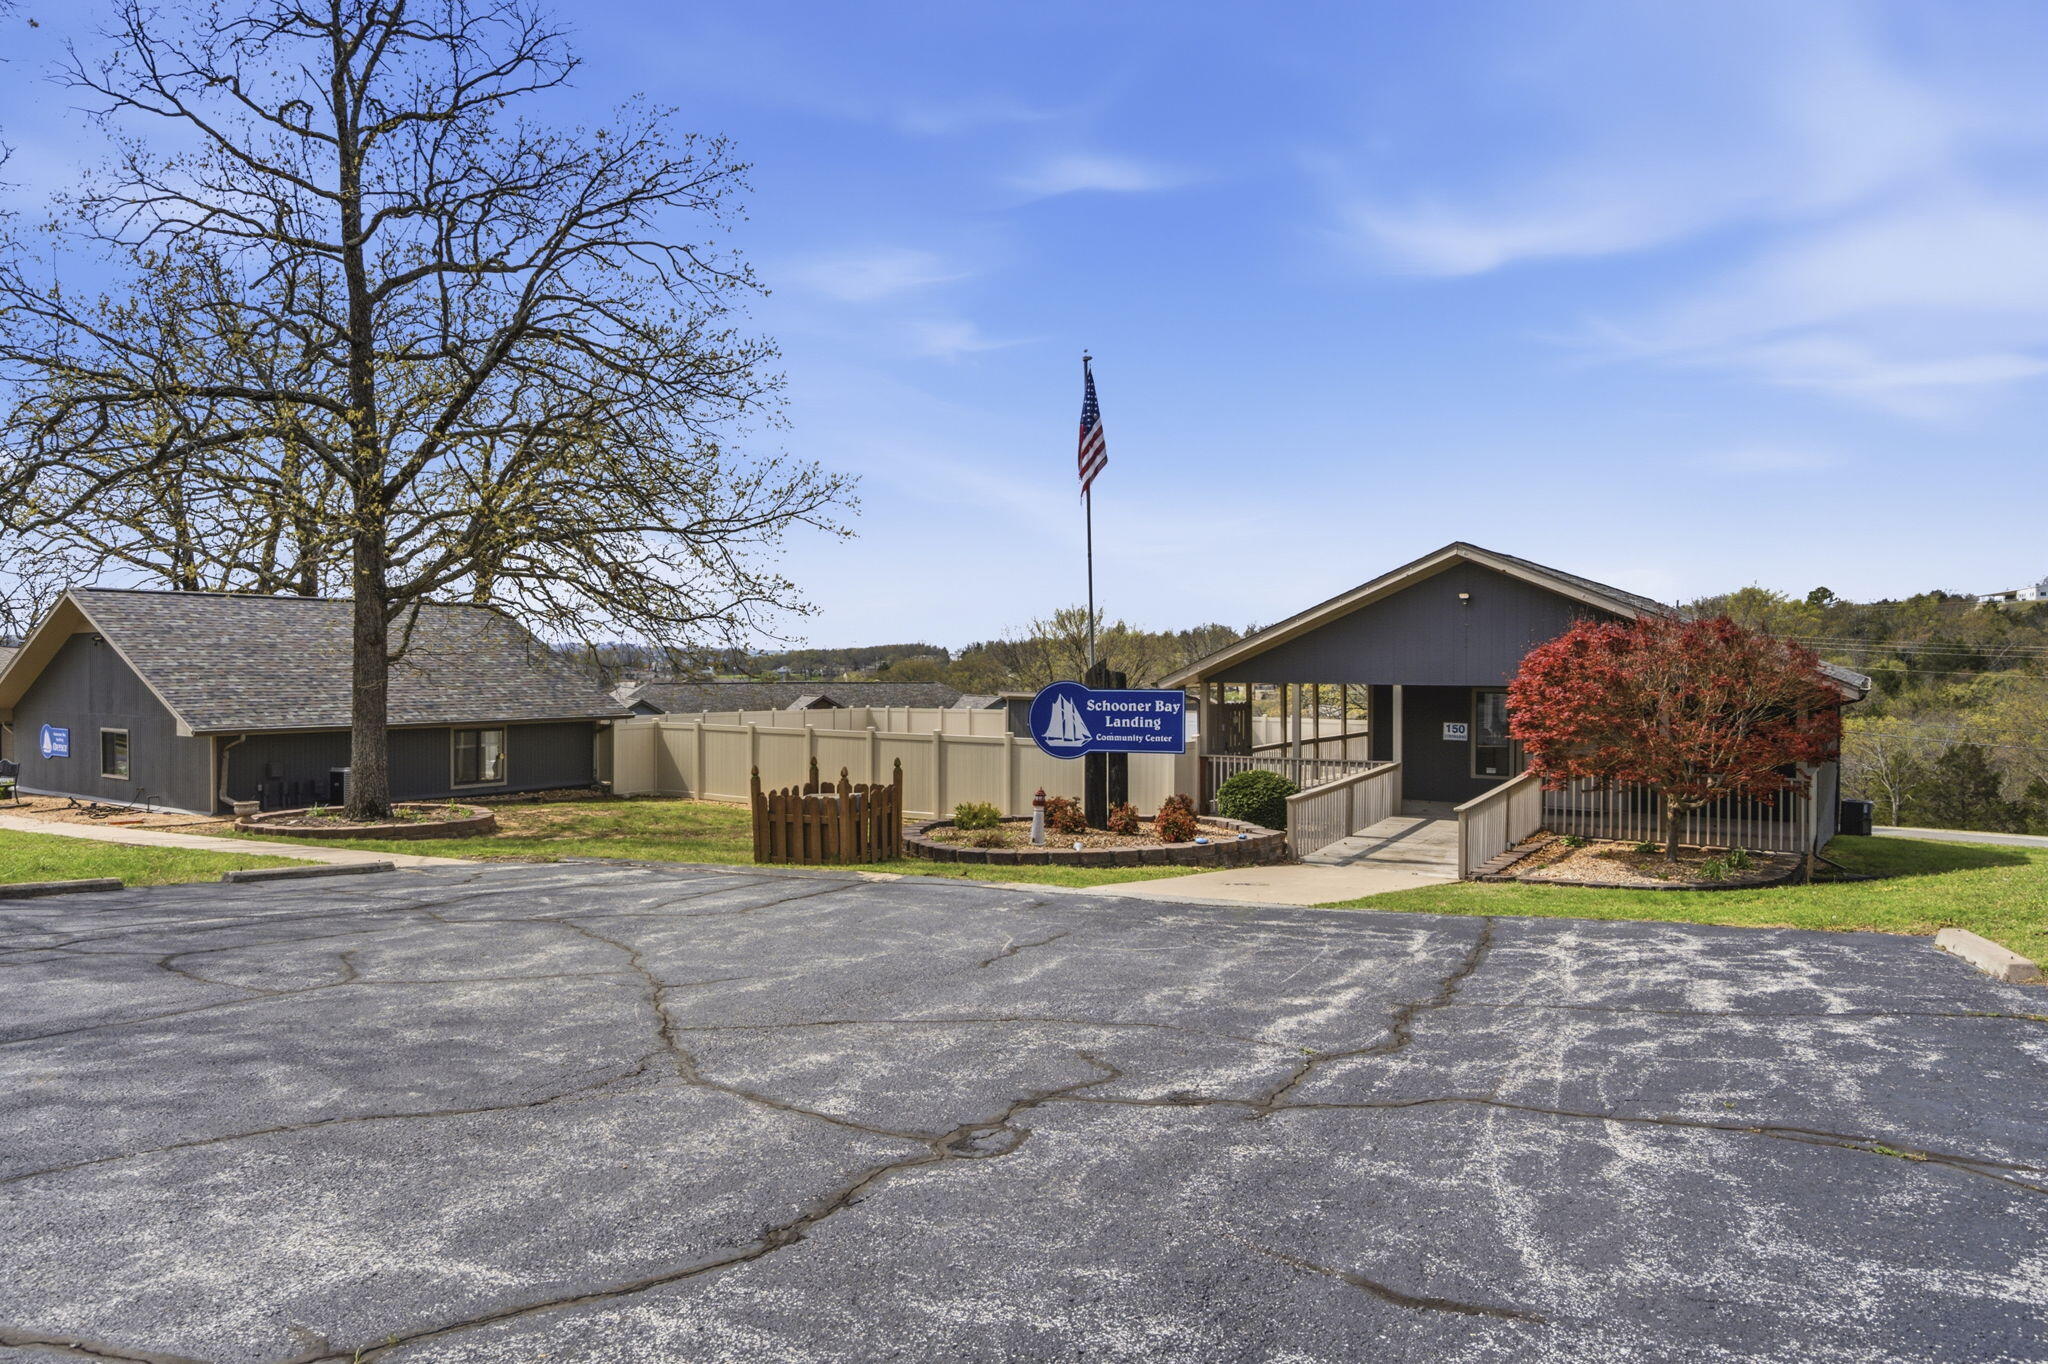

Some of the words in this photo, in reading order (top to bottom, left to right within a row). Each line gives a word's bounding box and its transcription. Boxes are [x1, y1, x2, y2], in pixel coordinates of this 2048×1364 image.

[1087, 699, 1151, 711] Schooner
[1155, 700, 1181, 714] Bay
[1105, 716, 1161, 730] Landing
[1446, 724, 1466, 734] 150
[1096, 734, 1143, 743] Community
[1145, 734, 1172, 742] Center
